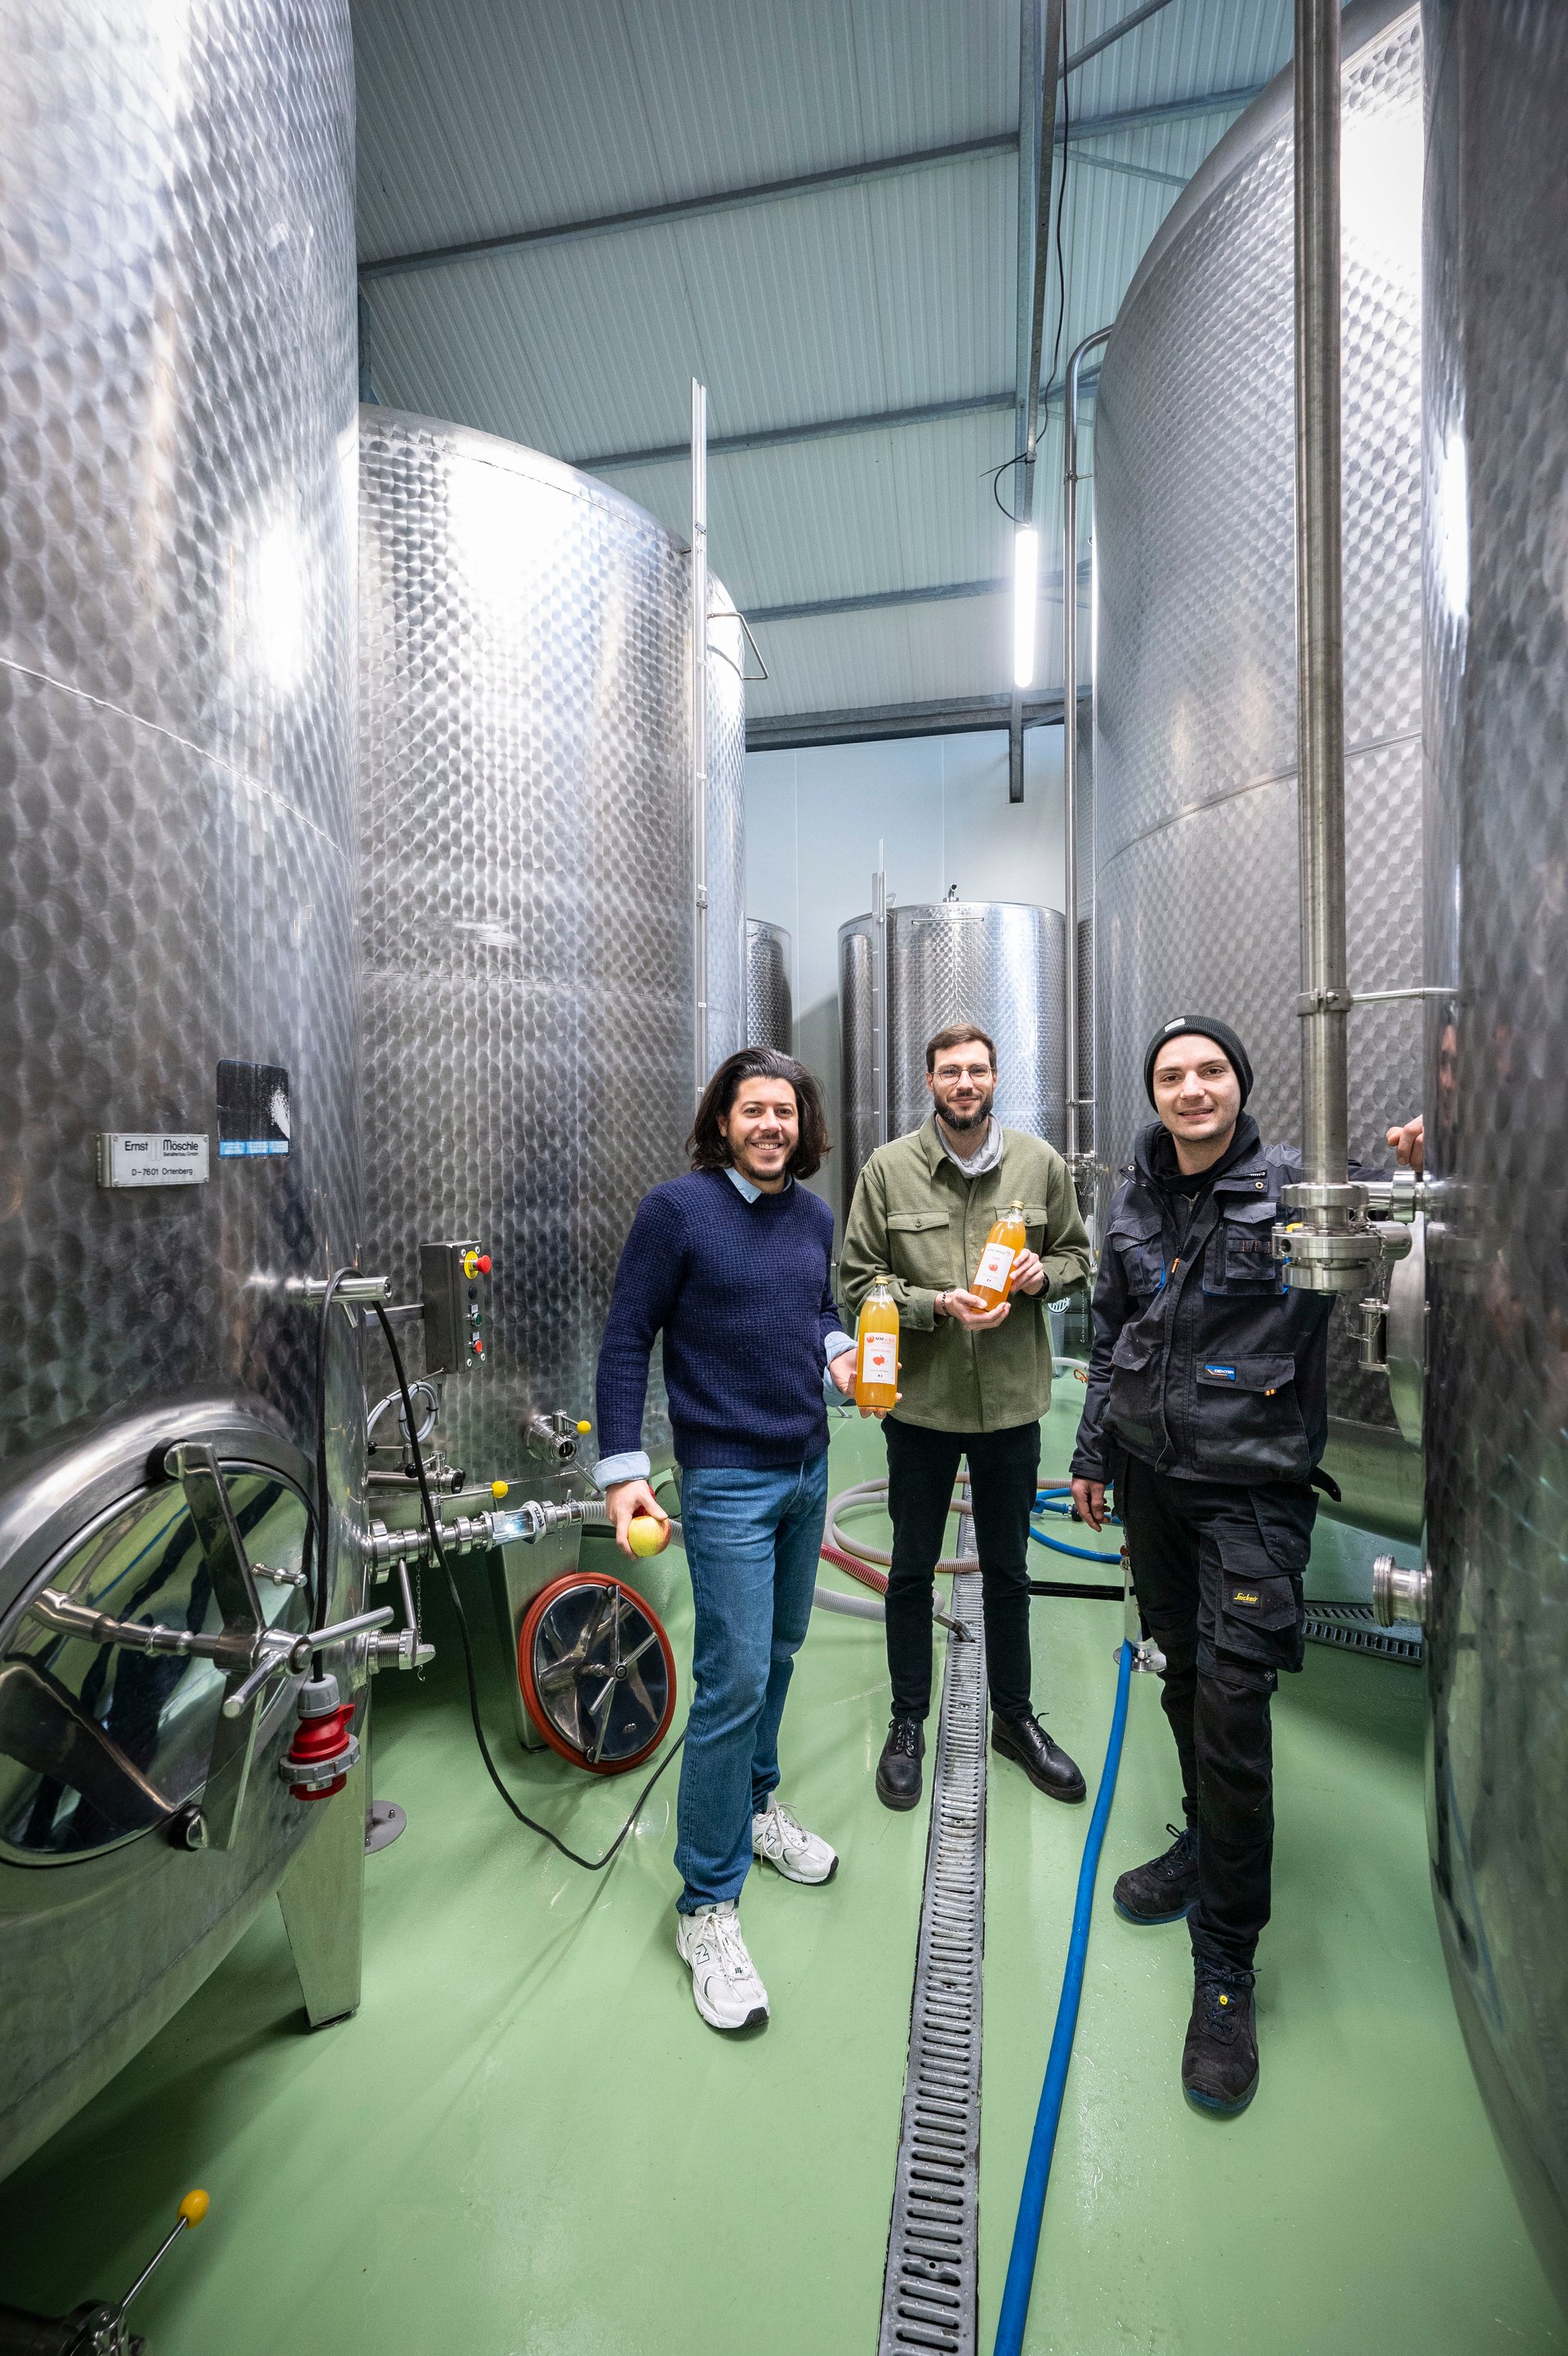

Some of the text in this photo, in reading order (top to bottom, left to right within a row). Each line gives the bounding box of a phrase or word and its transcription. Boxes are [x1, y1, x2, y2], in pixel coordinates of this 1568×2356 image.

[125, 1139, 198, 1151] Ernst Möschle
[131, 1168, 193, 1176] D-7601 Ortenberg
[695, 1944, 710, 1965] N
